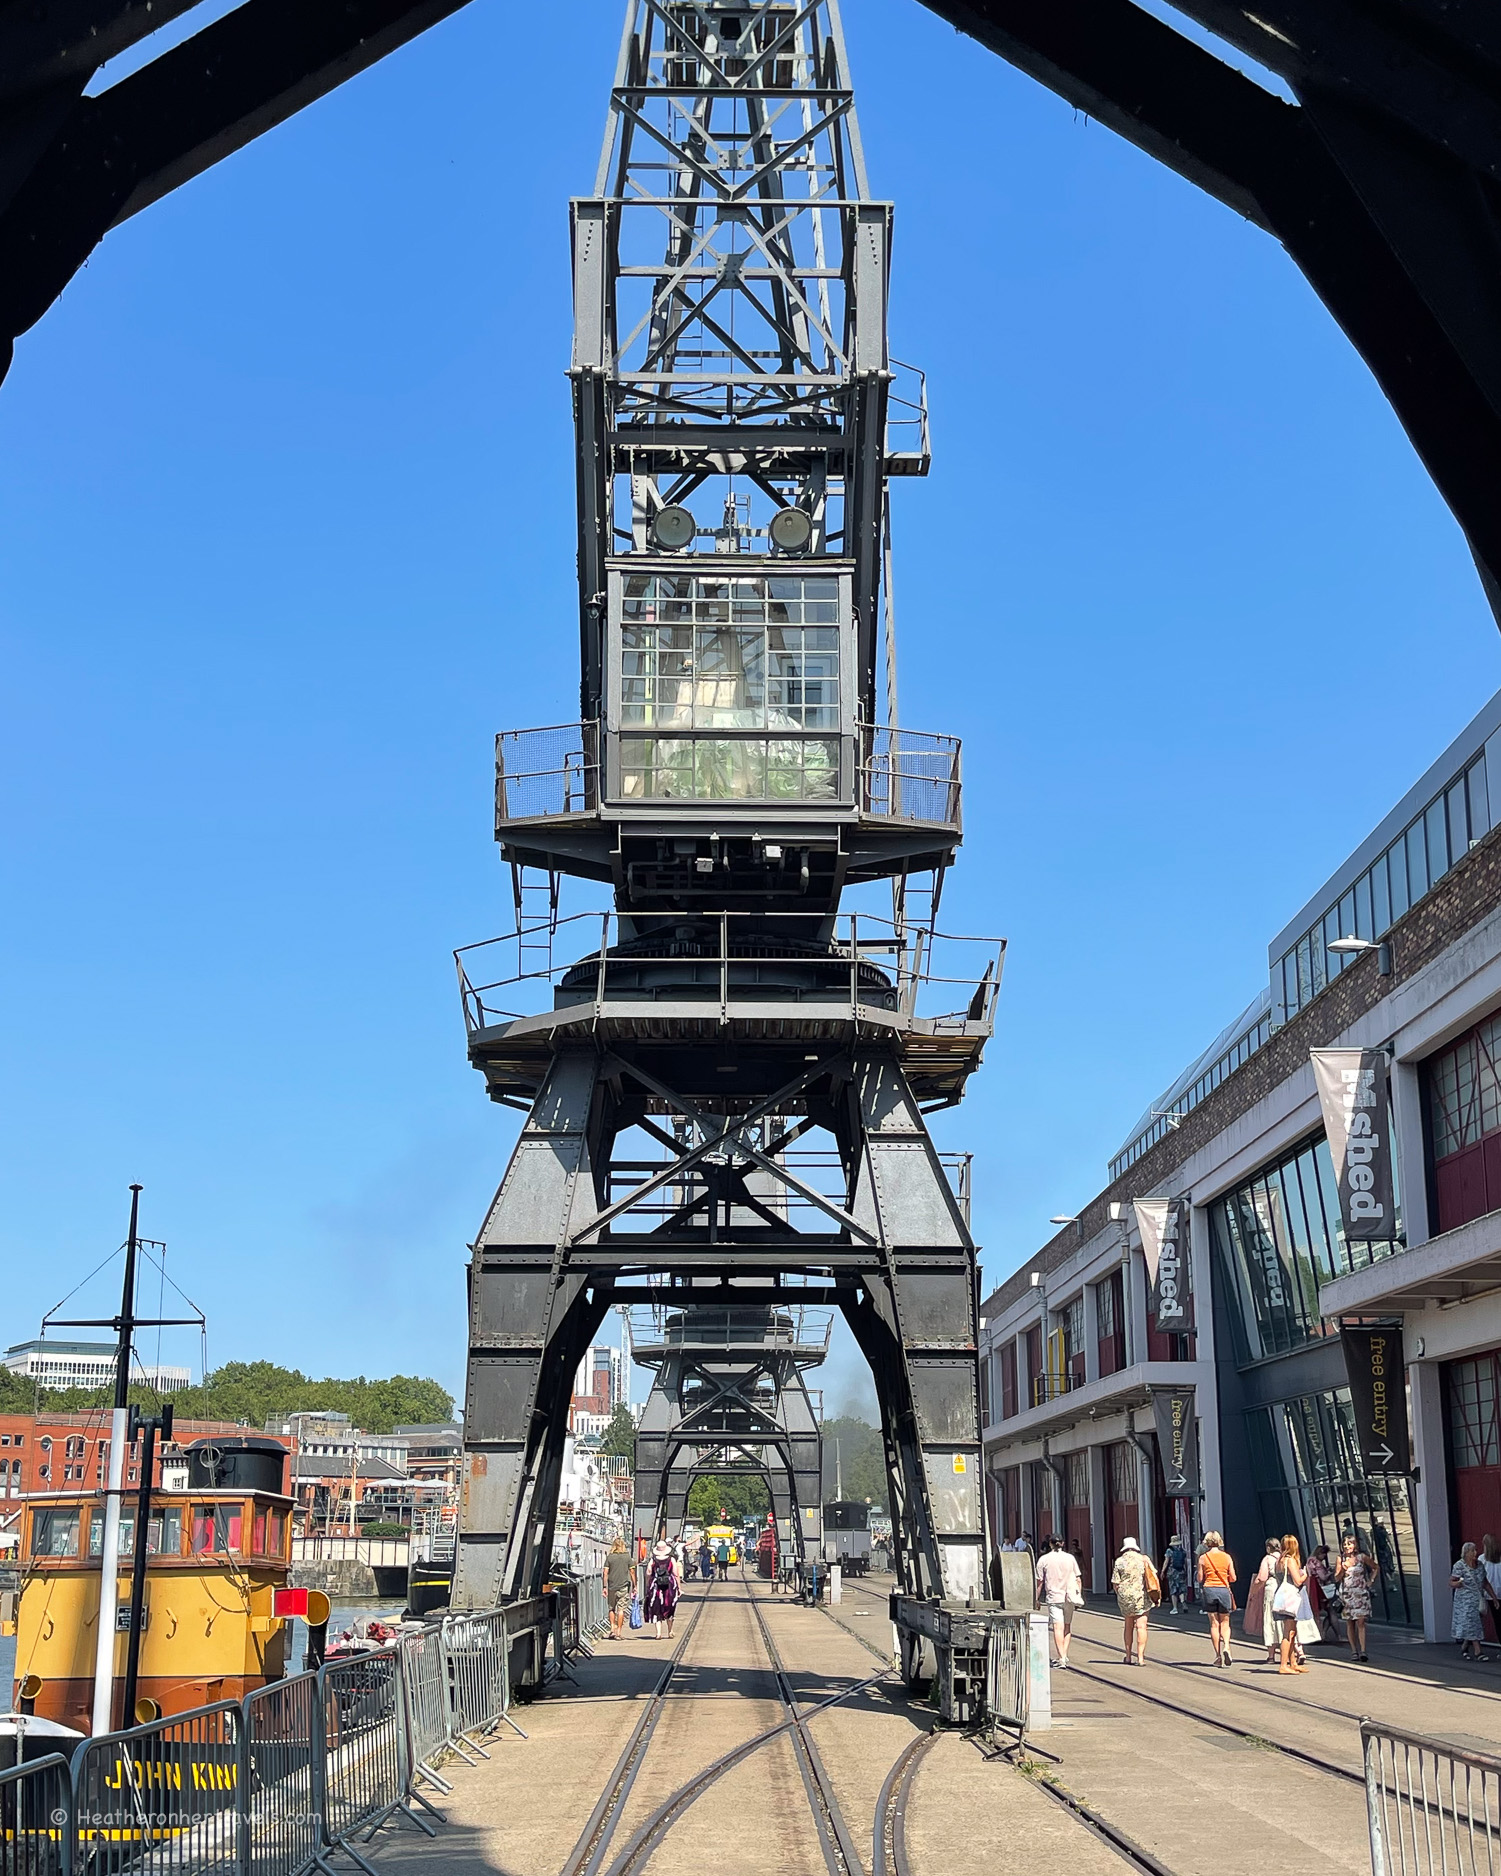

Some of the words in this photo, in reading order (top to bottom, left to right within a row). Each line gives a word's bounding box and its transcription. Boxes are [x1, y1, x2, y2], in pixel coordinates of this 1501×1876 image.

[1370, 1337, 1386, 1376] free
[1171, 1399, 1183, 1427] free
[1372, 1381, 1389, 1438] entry
[1172, 1430, 1184, 1469] entry
[105, 1759, 182, 1791] JOHN
[191, 1762, 238, 1791] KIN
